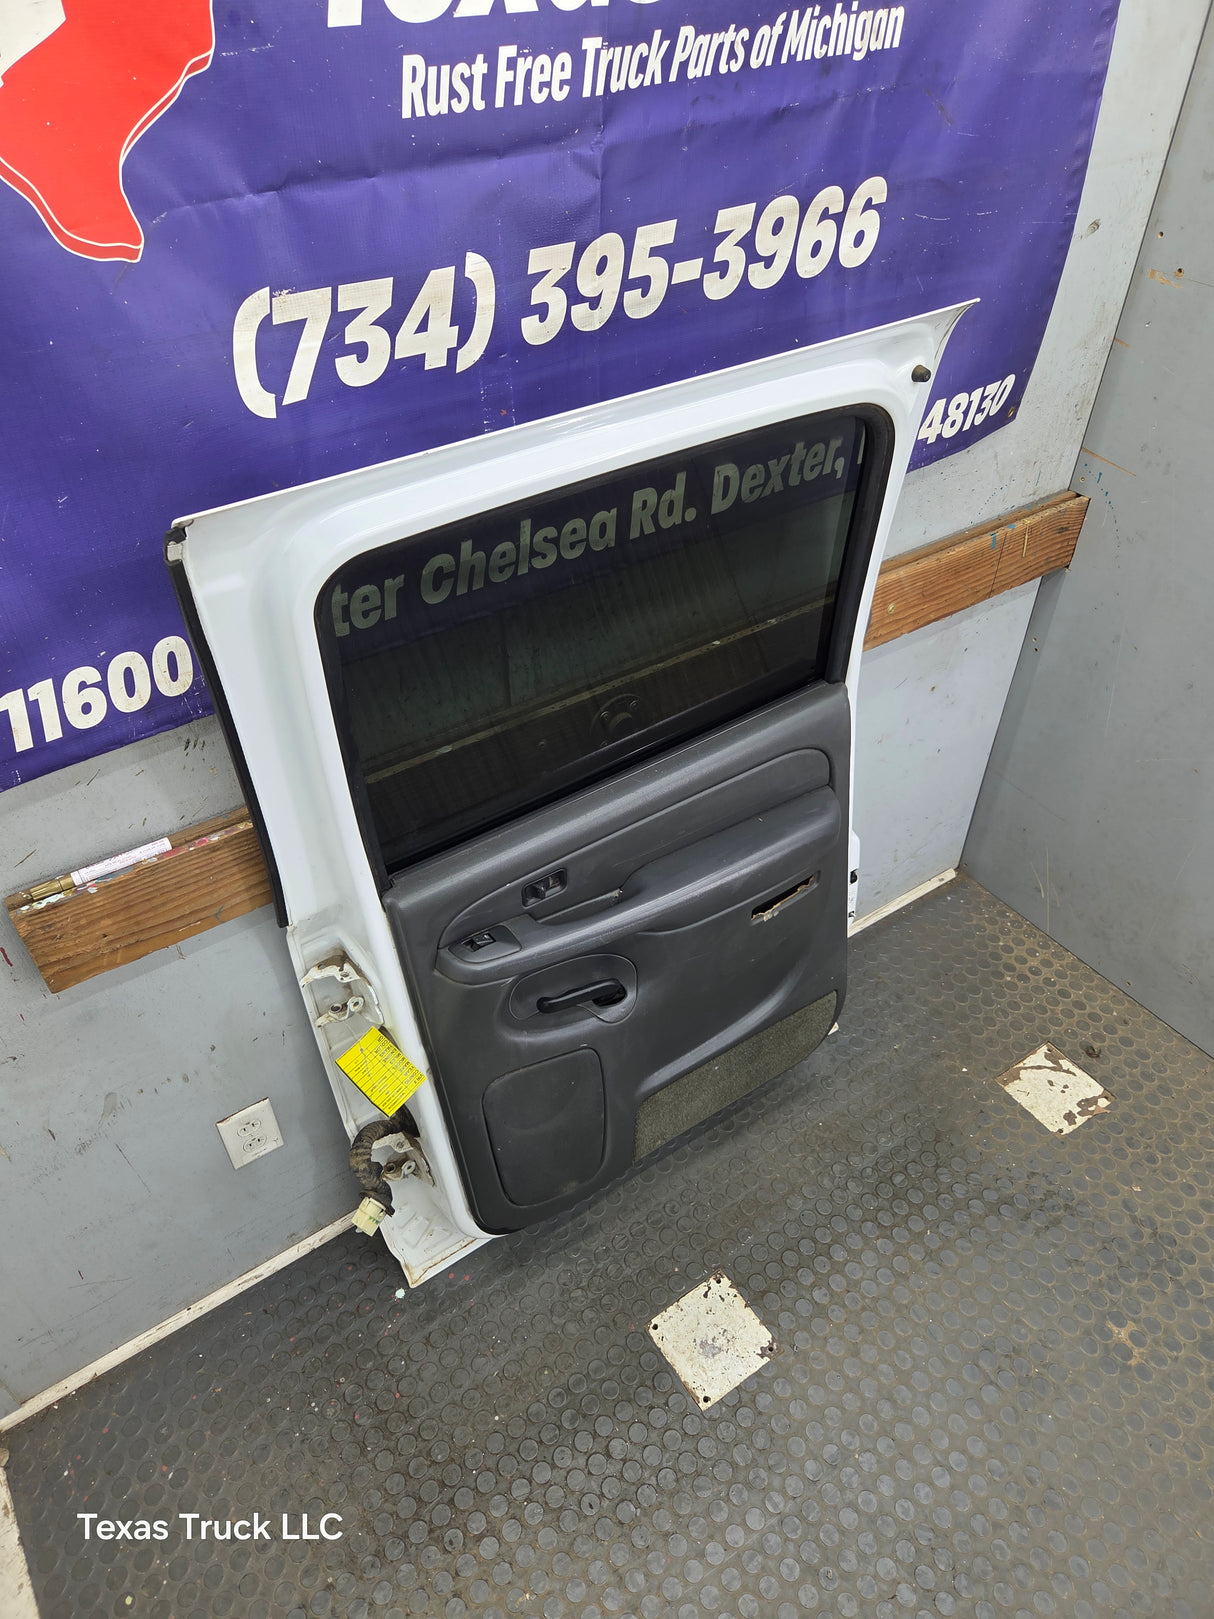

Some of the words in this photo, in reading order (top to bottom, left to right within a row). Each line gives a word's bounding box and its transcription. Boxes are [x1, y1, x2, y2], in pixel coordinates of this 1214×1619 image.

[402, 54, 488, 119] Rust
[494, 45, 572, 108] Free
[581, 29, 671, 98] Truck
[668, 24, 749, 82] Parts
[750, 12, 787, 69] of
[781, 1, 905, 64] Michigan
[233, 252, 495, 418] (734)
[521, 176, 888, 346] 395-3966
[0, 636, 193, 753] 11600
[420, 507, 617, 605] Chelsea
[630, 471, 697, 539] Rd.
[711, 437, 845, 515] Dexter,
[917, 374, 1016, 445] 48130
